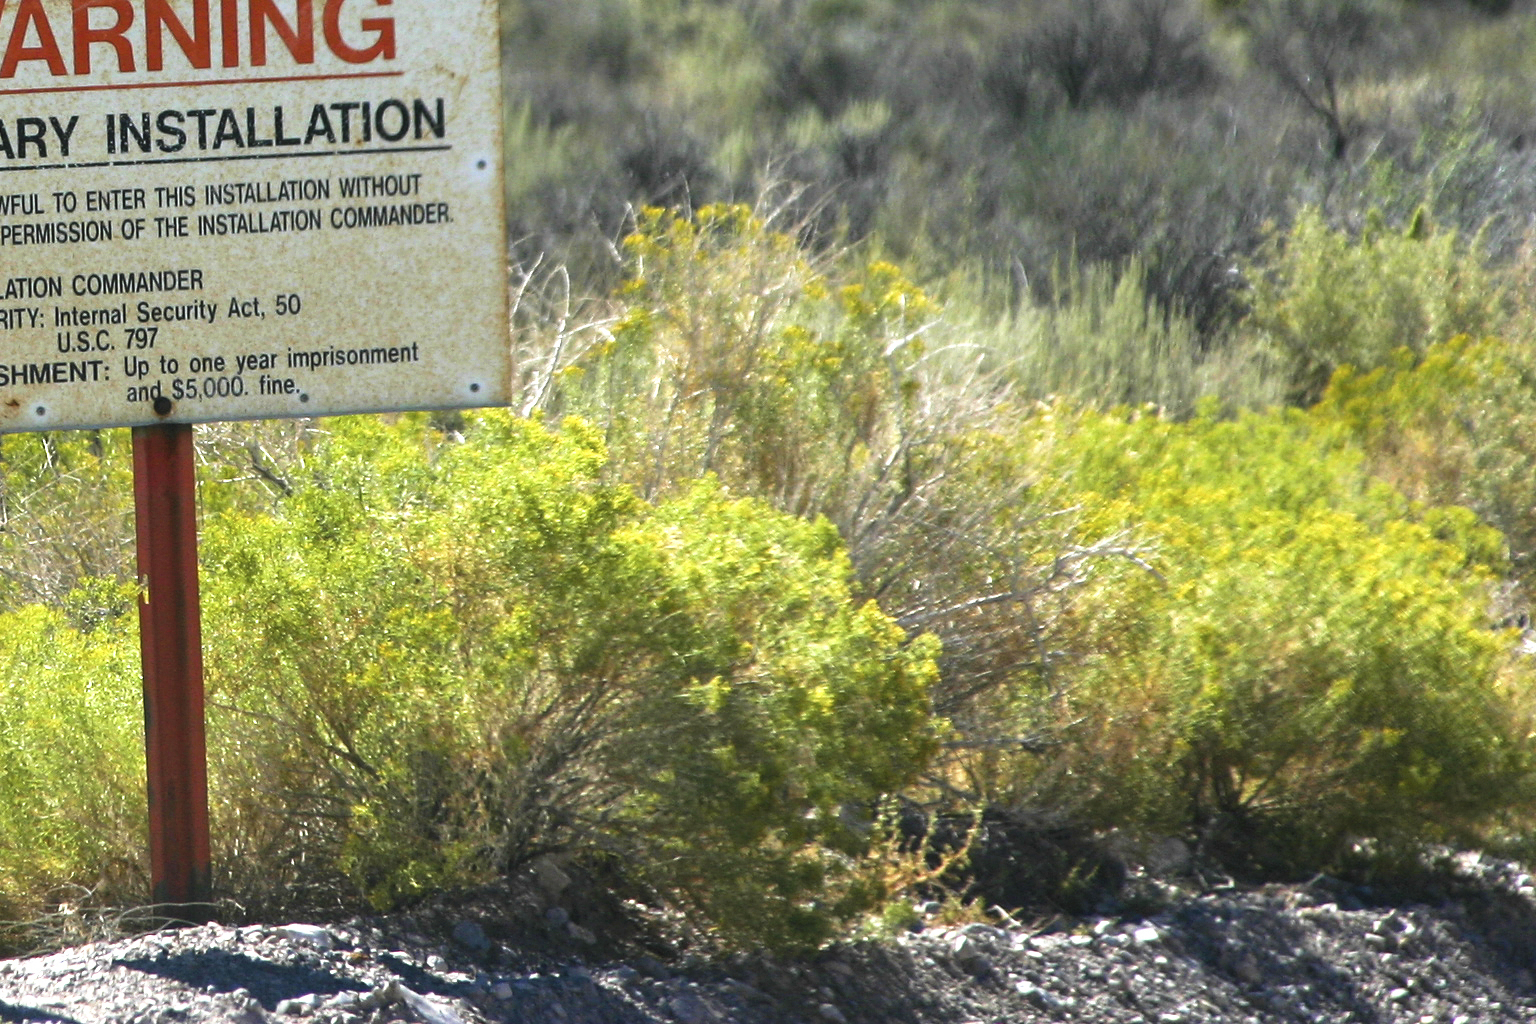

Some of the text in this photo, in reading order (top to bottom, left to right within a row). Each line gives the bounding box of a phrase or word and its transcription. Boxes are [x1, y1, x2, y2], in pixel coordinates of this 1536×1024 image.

[107, 98, 445, 154] INSTALLATION
[52, 191, 76, 213] TO
[87, 189, 145, 211] ENTER
[154, 186, 195, 208] THIS
[206, 179, 330, 205] INSTALLATION
[339, 174, 422, 198] WITHOUT
[1, 220, 112, 246] PERMISSION
[121, 219, 145, 240] OF
[154, 216, 188, 238] THE
[198, 209, 321, 236] INSTALLATION
[331, 203, 453, 230] COMMANDER.
[72, 269, 203, 296] COMMANDER
[55, 303, 126, 327] Internal
[137, 300, 217, 323] Security
[228, 297, 265, 320] Act,
[276, 294, 301, 315] 50
[58, 327, 158, 353] U.S.C. 797
[124, 356, 149, 380] Up
[160, 355, 178, 374] to
[190, 356, 225, 373] one
[236, 354, 278, 375] year
[288, 342, 418, 371] imprisonment
[127, 375, 299, 402] and $5,000. fine.
